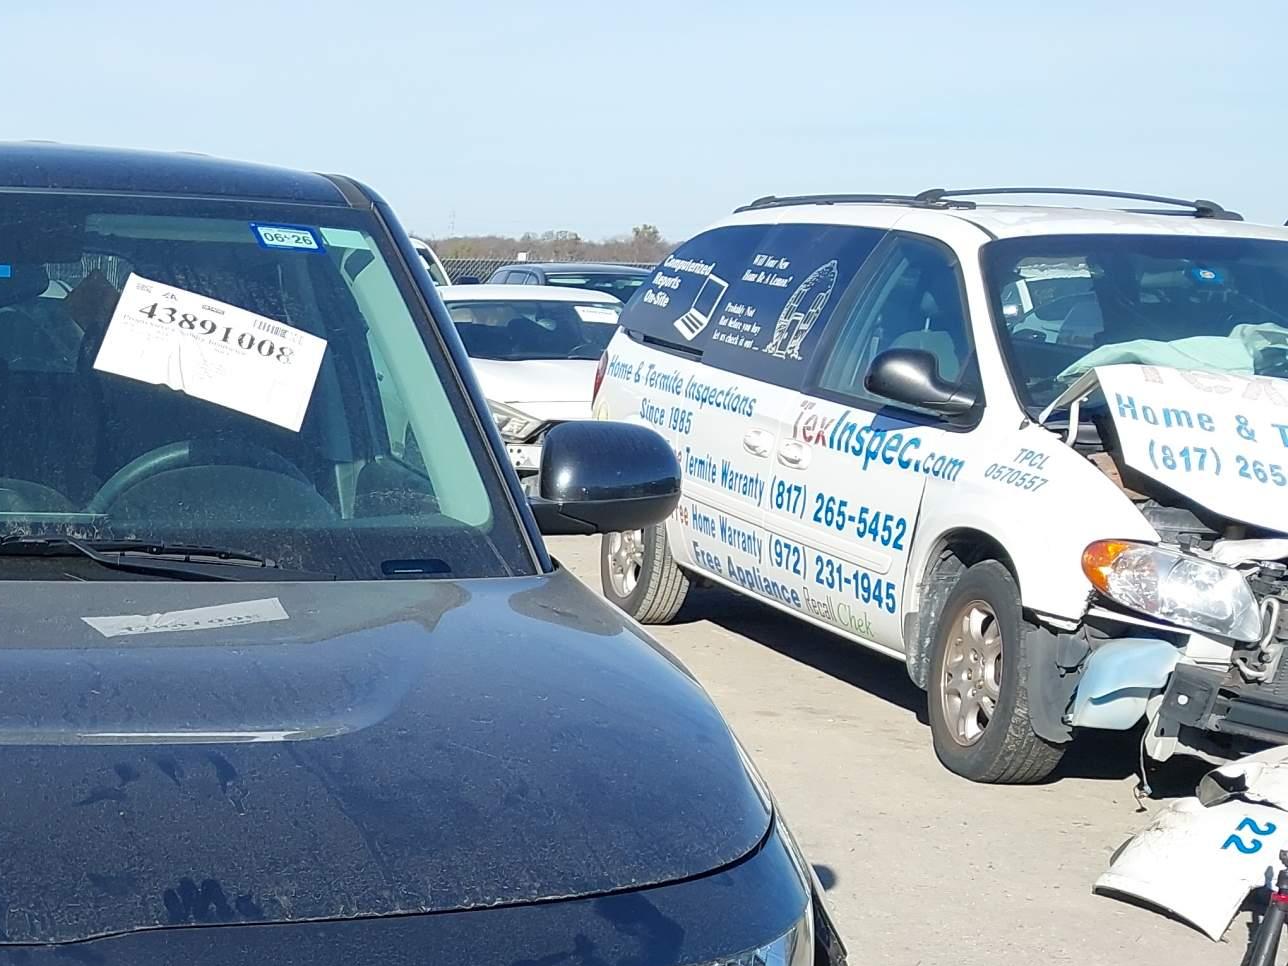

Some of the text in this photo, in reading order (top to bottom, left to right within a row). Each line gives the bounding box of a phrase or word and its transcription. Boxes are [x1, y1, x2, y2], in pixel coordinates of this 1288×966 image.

[652, 271, 682, 289] Reports
[664, 254, 716, 276] Computerized
[644, 289, 670, 307] On-Site
[138, 302, 294, 364] 43891008
[607, 354, 757, 417] Home & Termite Inspections
[640, 398, 694, 434] Since 1985
[1115, 392, 1215, 432] Home
[1234, 414, 1257, 443] &
[792, 400, 965, 482] TexInspec.com
[1013, 448, 1051, 471] TPCL
[1148, 439, 1222, 476] (817)
[685, 447, 906, 551] Termite Warranty (817) 265-5452
[984, 463, 1049, 492] 0570557
[692, 504, 716, 538] Home
[719, 514, 763, 563] Warranty
[768, 534, 807, 579] (972)
[815, 555, 897, 614] 231-1945
[692, 540, 874, 637] Free Appliance Recall Chek
